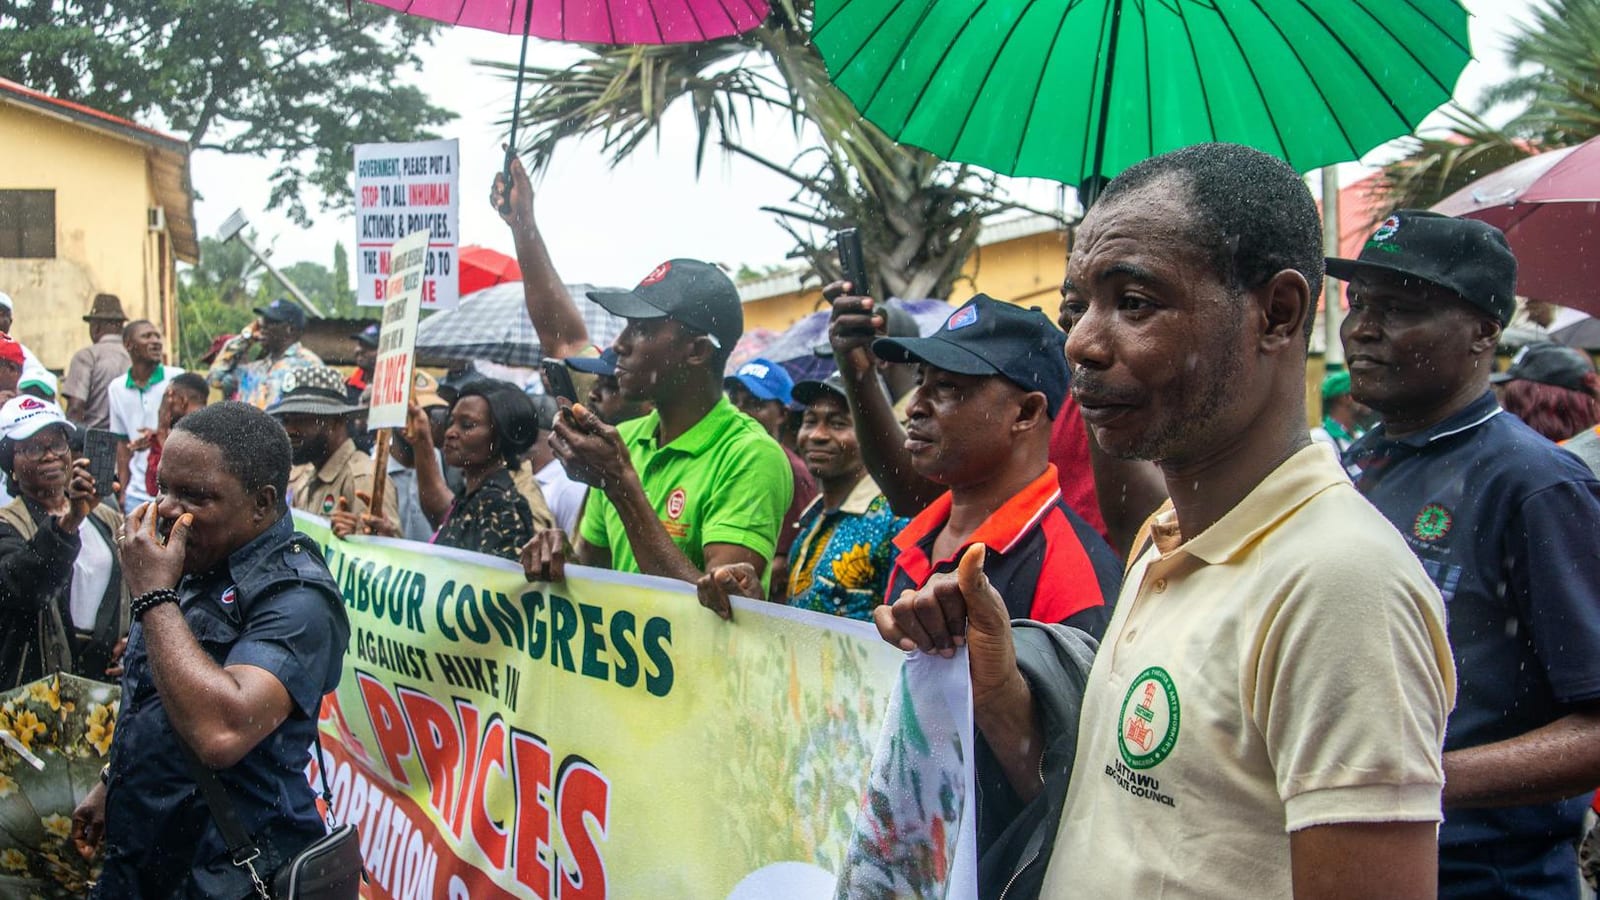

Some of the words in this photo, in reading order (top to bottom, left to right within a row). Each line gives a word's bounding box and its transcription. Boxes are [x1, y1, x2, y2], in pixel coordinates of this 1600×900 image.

[359, 158, 401, 179] GOVERNMENT,
[403, 156, 427, 176] PLEASE
[429, 155, 443, 175] PUT
[445, 155, 451, 174] A
[362, 185, 378, 208] STOP
[381, 185, 390, 207] TO
[393, 184, 406, 207] ALL
[409, 183, 450, 207] INHUMAN
[363, 214, 395, 239] ACTIONS
[398, 214, 404, 239] &
[364, 251, 376, 274] THE
[439, 251, 450, 276] TO
[384, 353, 407, 405] PRICE
[436, 579, 675, 698] CONGRESS
[357, 627, 434, 682] AGAINST
[435, 652, 499, 698] HIKE
[505, 664, 520, 713] IN
[355, 667, 611, 900] PRICES
[1130, 785, 1176, 808] COUNCIL
[306, 741, 438, 900] PORTATION
